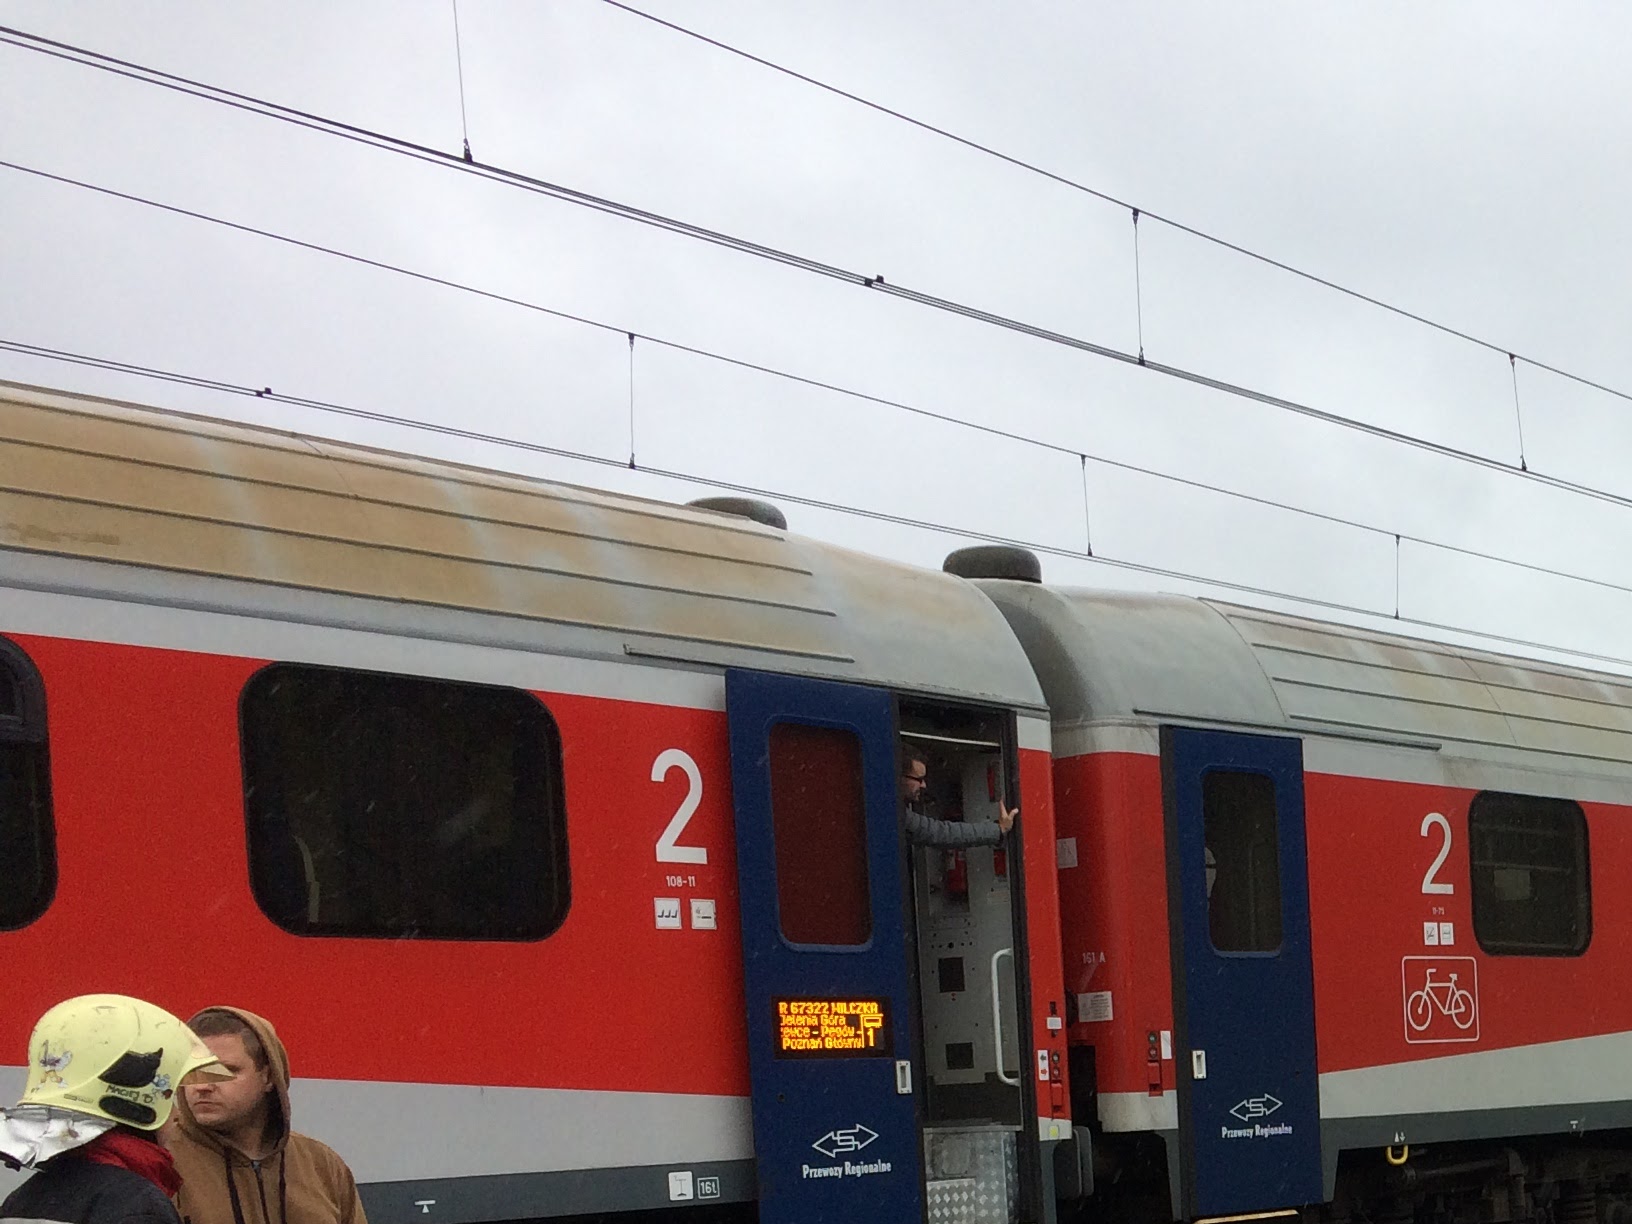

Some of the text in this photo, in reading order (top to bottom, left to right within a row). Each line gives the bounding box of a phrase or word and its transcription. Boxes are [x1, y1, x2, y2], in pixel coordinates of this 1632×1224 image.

[651, 748, 708, 864] 2
[1420, 812, 1454, 894] 2
[666, 875, 696, 887] 108-11
[778, 1002, 788, 1014] R
[790, 1002, 829, 1014] 67322
[867, 1027, 875, 1046] 1
[1221, 1122, 1293, 1139] Przewozy Regionalne
[802, 1159, 892, 1179] Przewozy Regionalne
[700, 1181, 717, 1195] 16t
